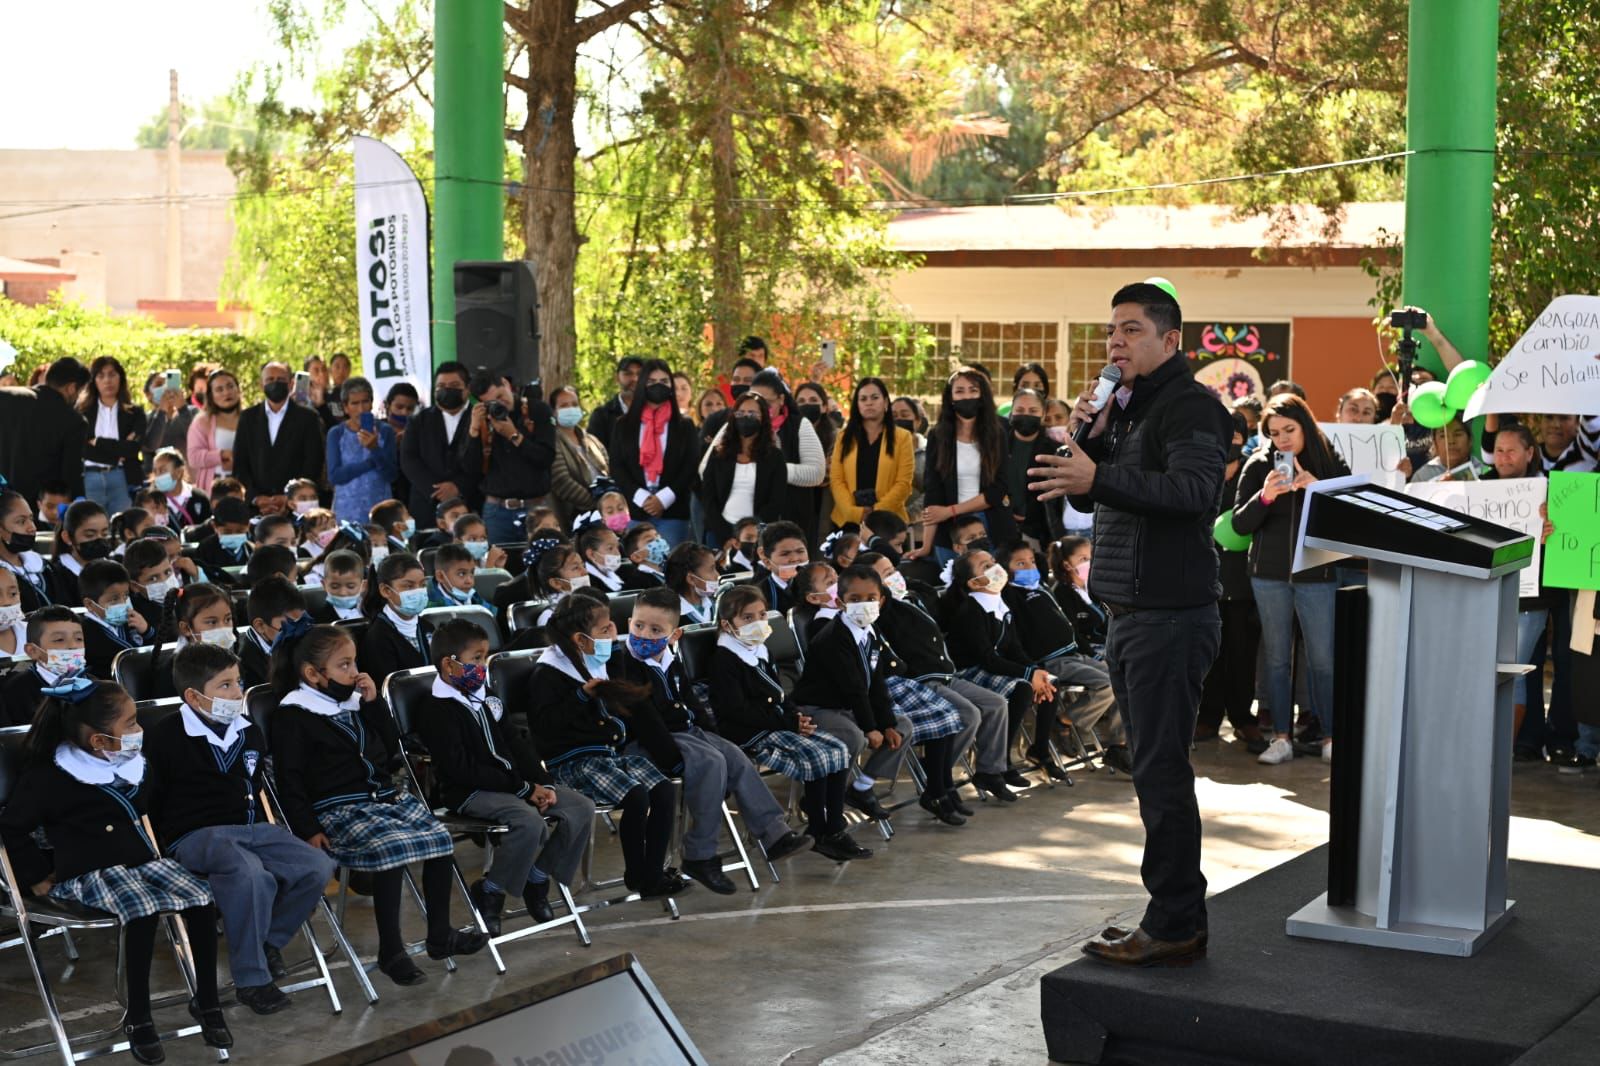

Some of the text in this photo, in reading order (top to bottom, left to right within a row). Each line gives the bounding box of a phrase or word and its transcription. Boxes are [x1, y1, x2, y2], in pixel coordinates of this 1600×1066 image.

[387, 214, 398, 301] POTOSINOS
[402, 263, 410, 302] ESTADO
[392, 303, 402, 332] LOS
